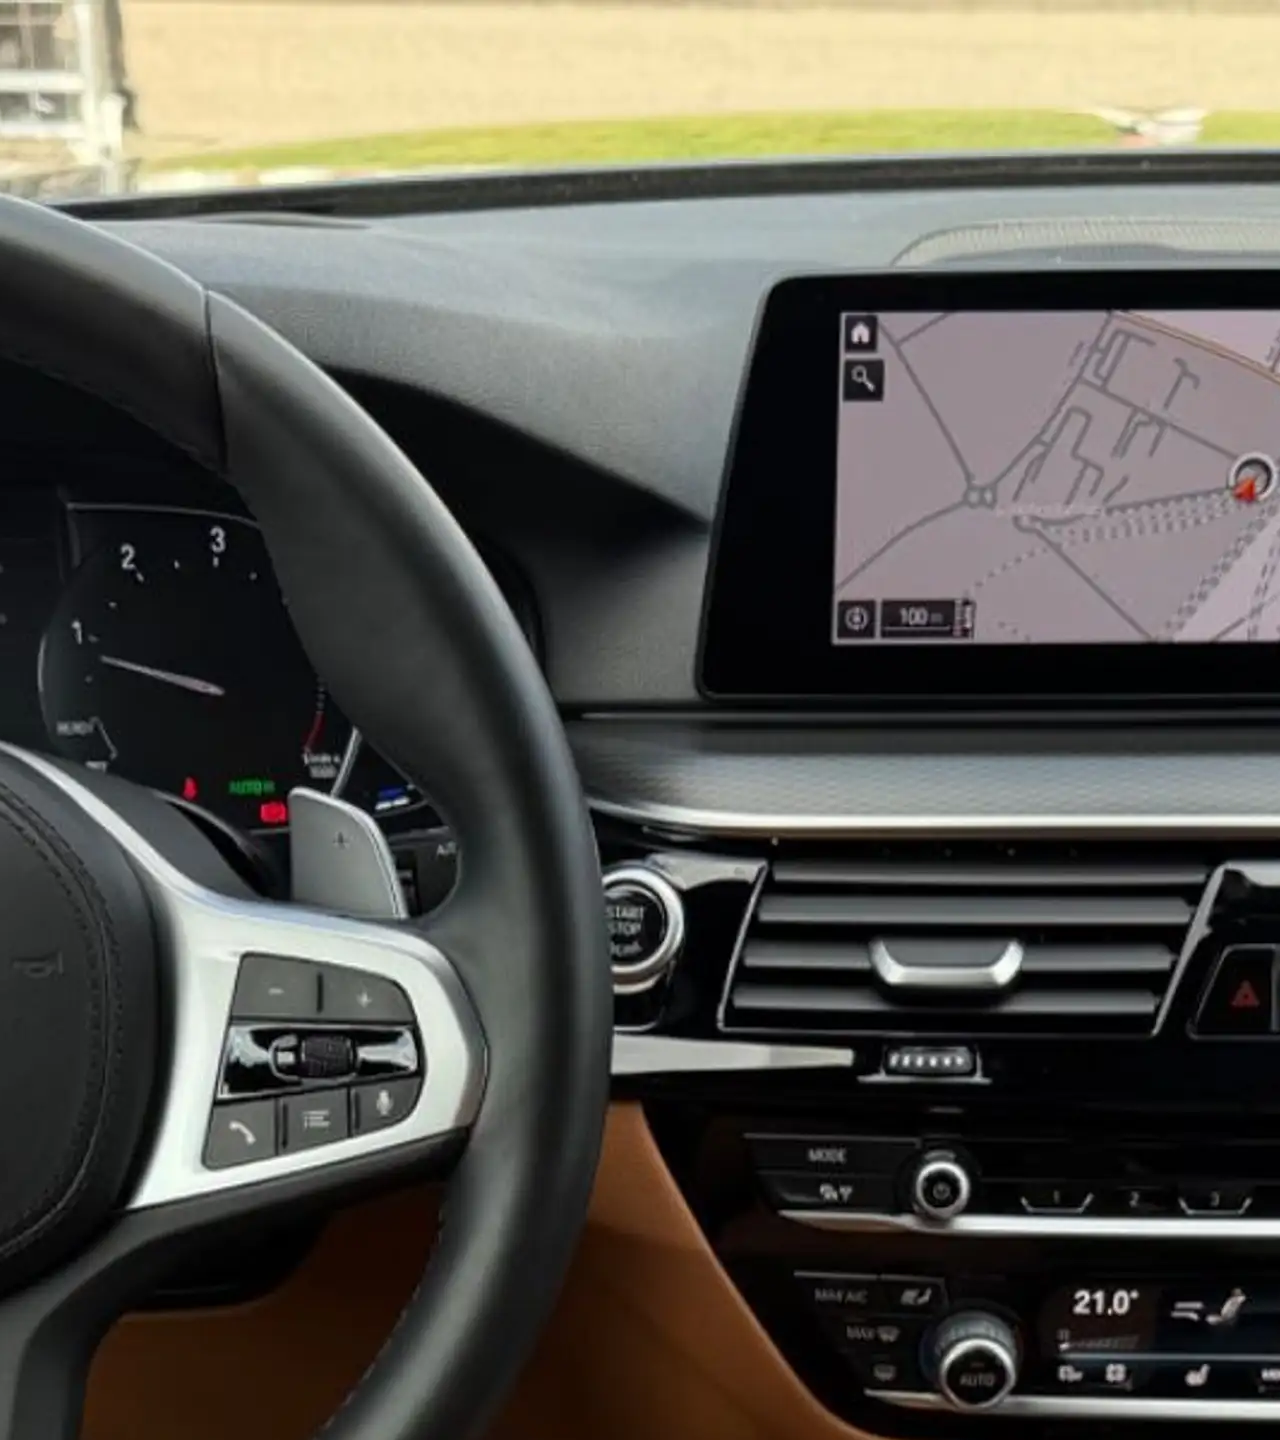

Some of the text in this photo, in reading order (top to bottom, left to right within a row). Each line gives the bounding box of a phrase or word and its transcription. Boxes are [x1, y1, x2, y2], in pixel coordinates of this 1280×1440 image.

[210, 527, 226, 551] 3
[120, 545, 136, 570] 2
[900, 606, 929, 626] 100
[71, 620, 83, 645] 1
[605, 905, 644, 919] START
[607, 920, 641, 936] STOP
[808, 1148, 847, 1163] MODE
[1072, 1288, 1140, 1316] 21.0°
[959, 1370, 995, 1388] AUTO
